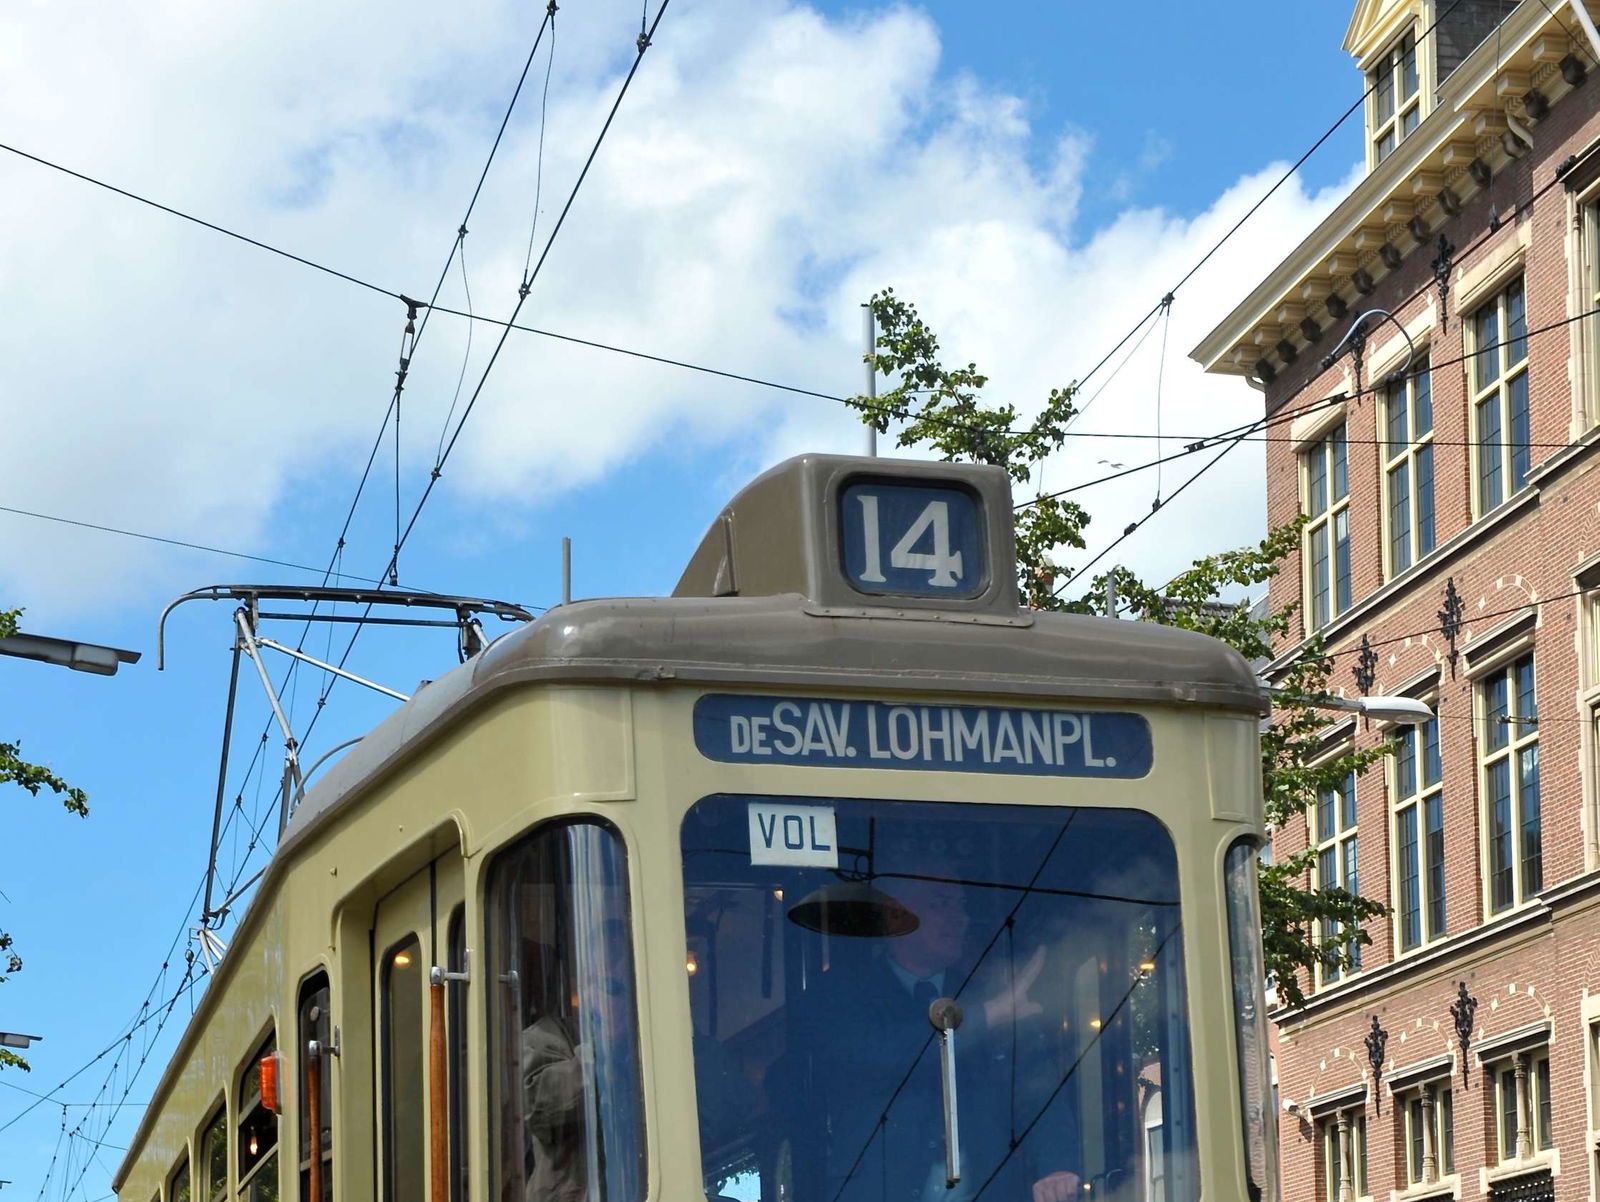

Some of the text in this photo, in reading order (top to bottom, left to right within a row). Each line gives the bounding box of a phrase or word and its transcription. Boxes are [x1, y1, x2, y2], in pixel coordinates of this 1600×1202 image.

[856, 495, 964, 588] 14
[867, 705, 1117, 767] LOHMANPL.
[757, 812, 831, 852] VOL
